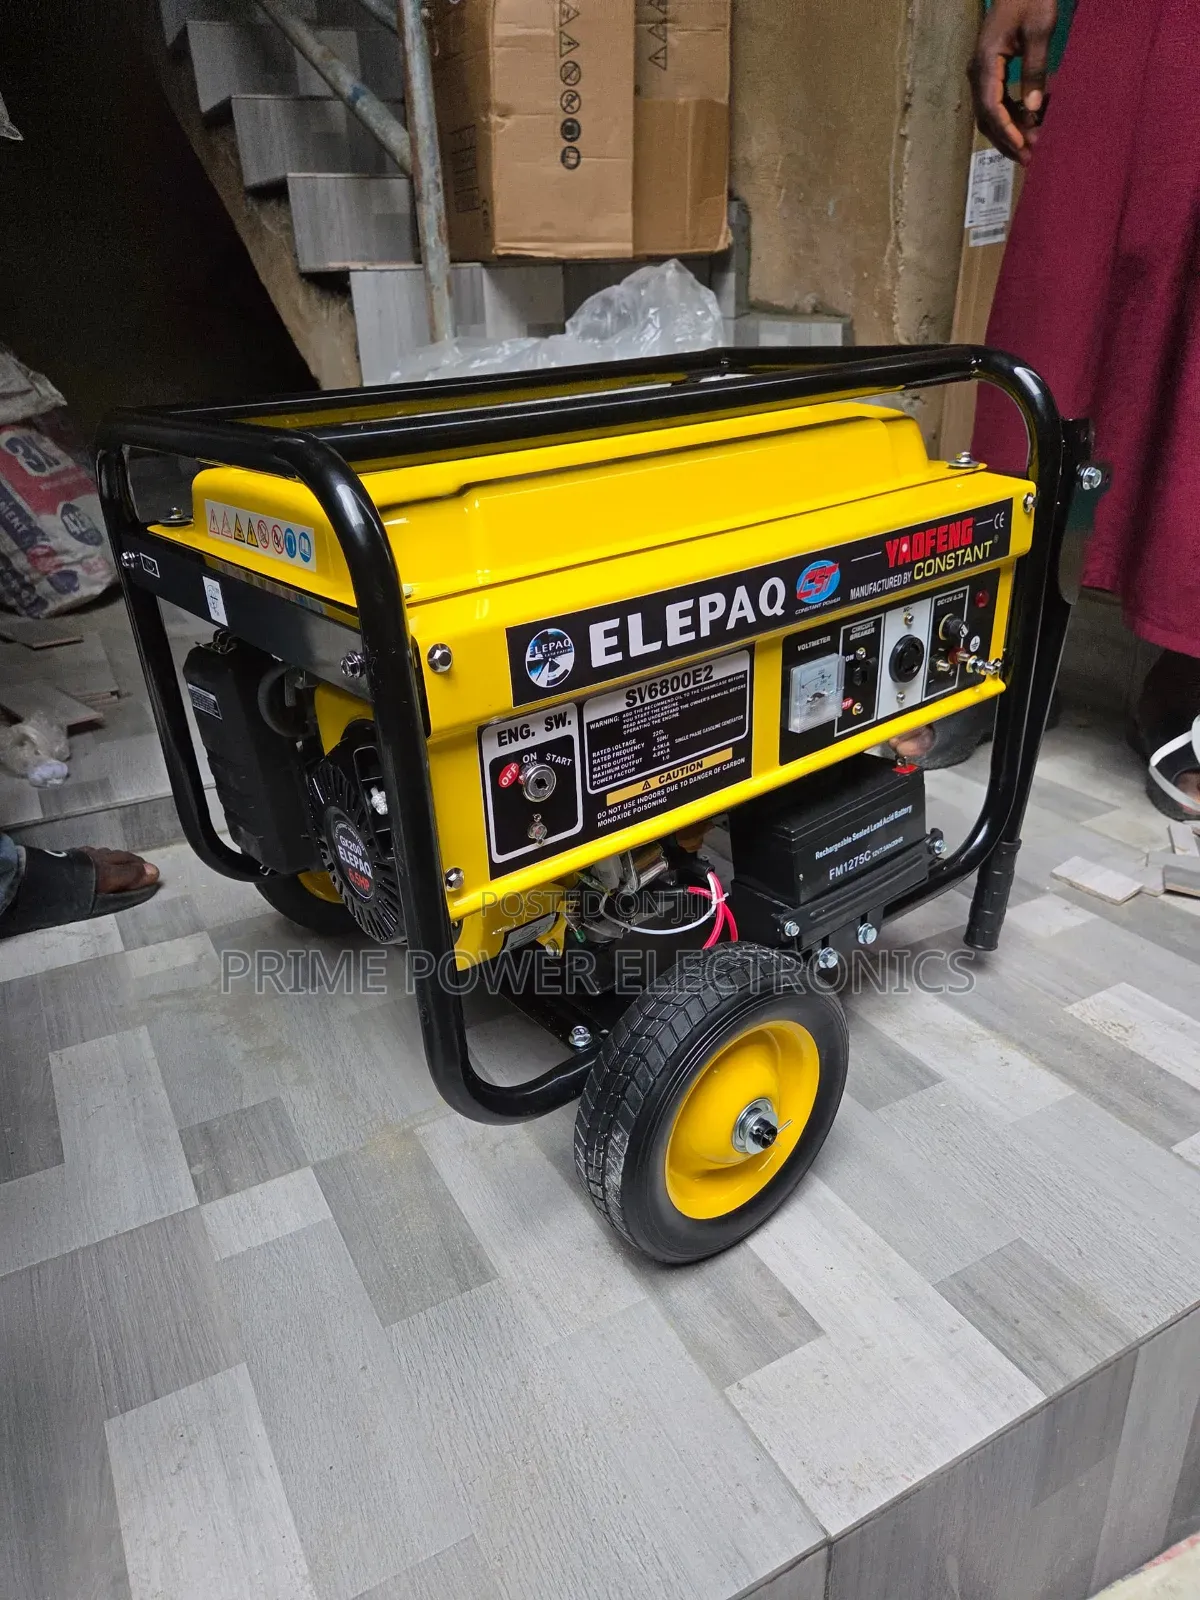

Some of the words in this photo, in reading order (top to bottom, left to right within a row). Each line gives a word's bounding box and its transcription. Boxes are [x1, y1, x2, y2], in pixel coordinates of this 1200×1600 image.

[885, 517, 975, 568] YAOFENG
[850, 573, 902, 600] MANUFACTURED
[903, 570, 912, 585] BY
[913, 540, 993, 580] CONSTANT
[588, 576, 786, 668] ELEPAQ
[851, 621, 875, 634] CIRCUIT
[797, 635, 831, 651] VOLTMETER
[625, 664, 714, 708] SV6800E2
[589, 715, 620, 730] WARNING:
[644, 698, 674, 711] RECOMMEND
[622, 720, 636, 730] READ
[636, 717, 648, 725] AND
[648, 706, 680, 721] UNDERSTAND
[710, 690, 729, 699] MANUAL
[623, 716, 634, 724] YOU
[634, 712, 650, 720] START
[661, 701, 679, 711] ENGINE
[497, 723, 536, 748] ENG.
[544, 711, 572, 733] SW.
[623, 722, 651, 735] OPERATING
[652, 718, 661, 726] THE
[661, 712, 680, 722] ENGINE
[689, 729, 702, 739] PHASE
[522, 752, 538, 763] ON
[545, 752, 573, 766] START
[592, 748, 611, 758] RATED
[592, 754, 611, 765] RATED
[612, 742, 645, 758] FREQUENCY
[592, 762, 612, 773] RATED
[612, 753, 635, 765] OUTPUT
[501, 763, 519, 786] OFF
[592, 766, 620, 780] MAXIMUM
[620, 757, 643, 770] OUTPUT
[592, 776, 613, 787] POWER
[613, 767, 636, 779] FACTOR
[658, 760, 704, 784] CAUTION
[597, 810, 607, 820] DO
[608, 805, 621, 815] NOT
[623, 800, 636, 810] USE
[637, 788, 665, 804] INDOORS
[666, 783, 679, 793] DUE
[680, 780, 688, 788] TO
[689, 769, 713, 784] DANGER
[713, 766, 721, 774] OF
[722, 757, 746, 771] CARBON
[597, 810, 632, 828] MONOXIDE
[632, 796, 668, 815] POISONING
[815, 836, 852, 860] Rechargeable
[852, 825, 870, 841] Sealed
[870, 818, 883, 832] Lead
[883, 813, 895, 825] Acid
[894, 805, 913, 819] Battery
[339, 835, 362, 856] GX200
[337, 845, 373, 879] ELEPAQ
[829, 850, 872, 880] FM1275C
